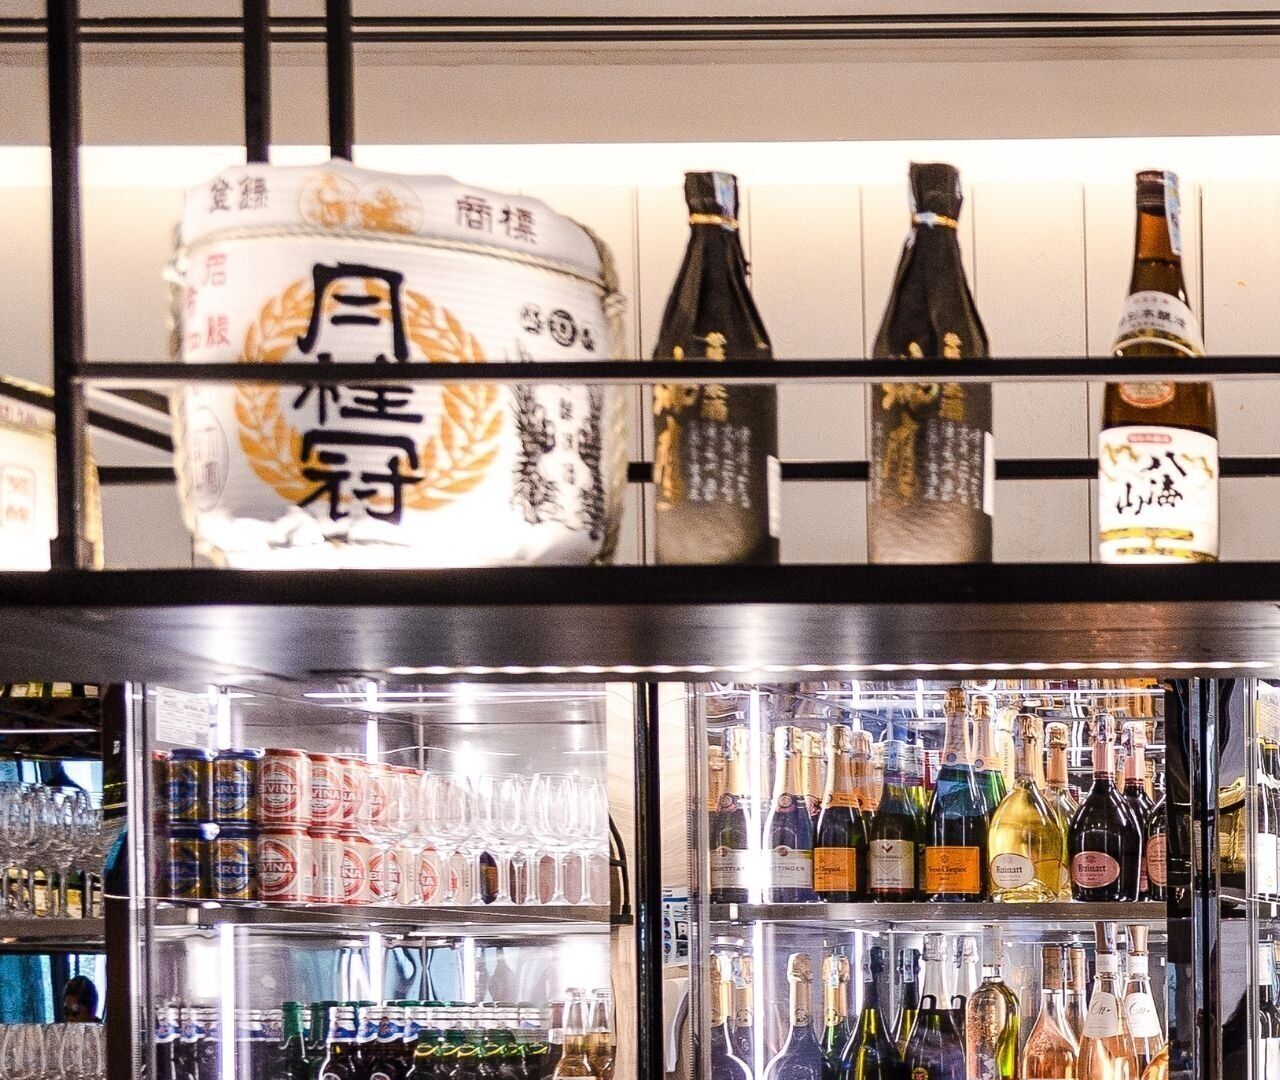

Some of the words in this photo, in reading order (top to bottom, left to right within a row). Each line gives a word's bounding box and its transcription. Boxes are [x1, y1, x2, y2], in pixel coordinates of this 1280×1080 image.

[292, 261, 425, 526] 月桂冠
[311, 789, 341, 800] VINA
